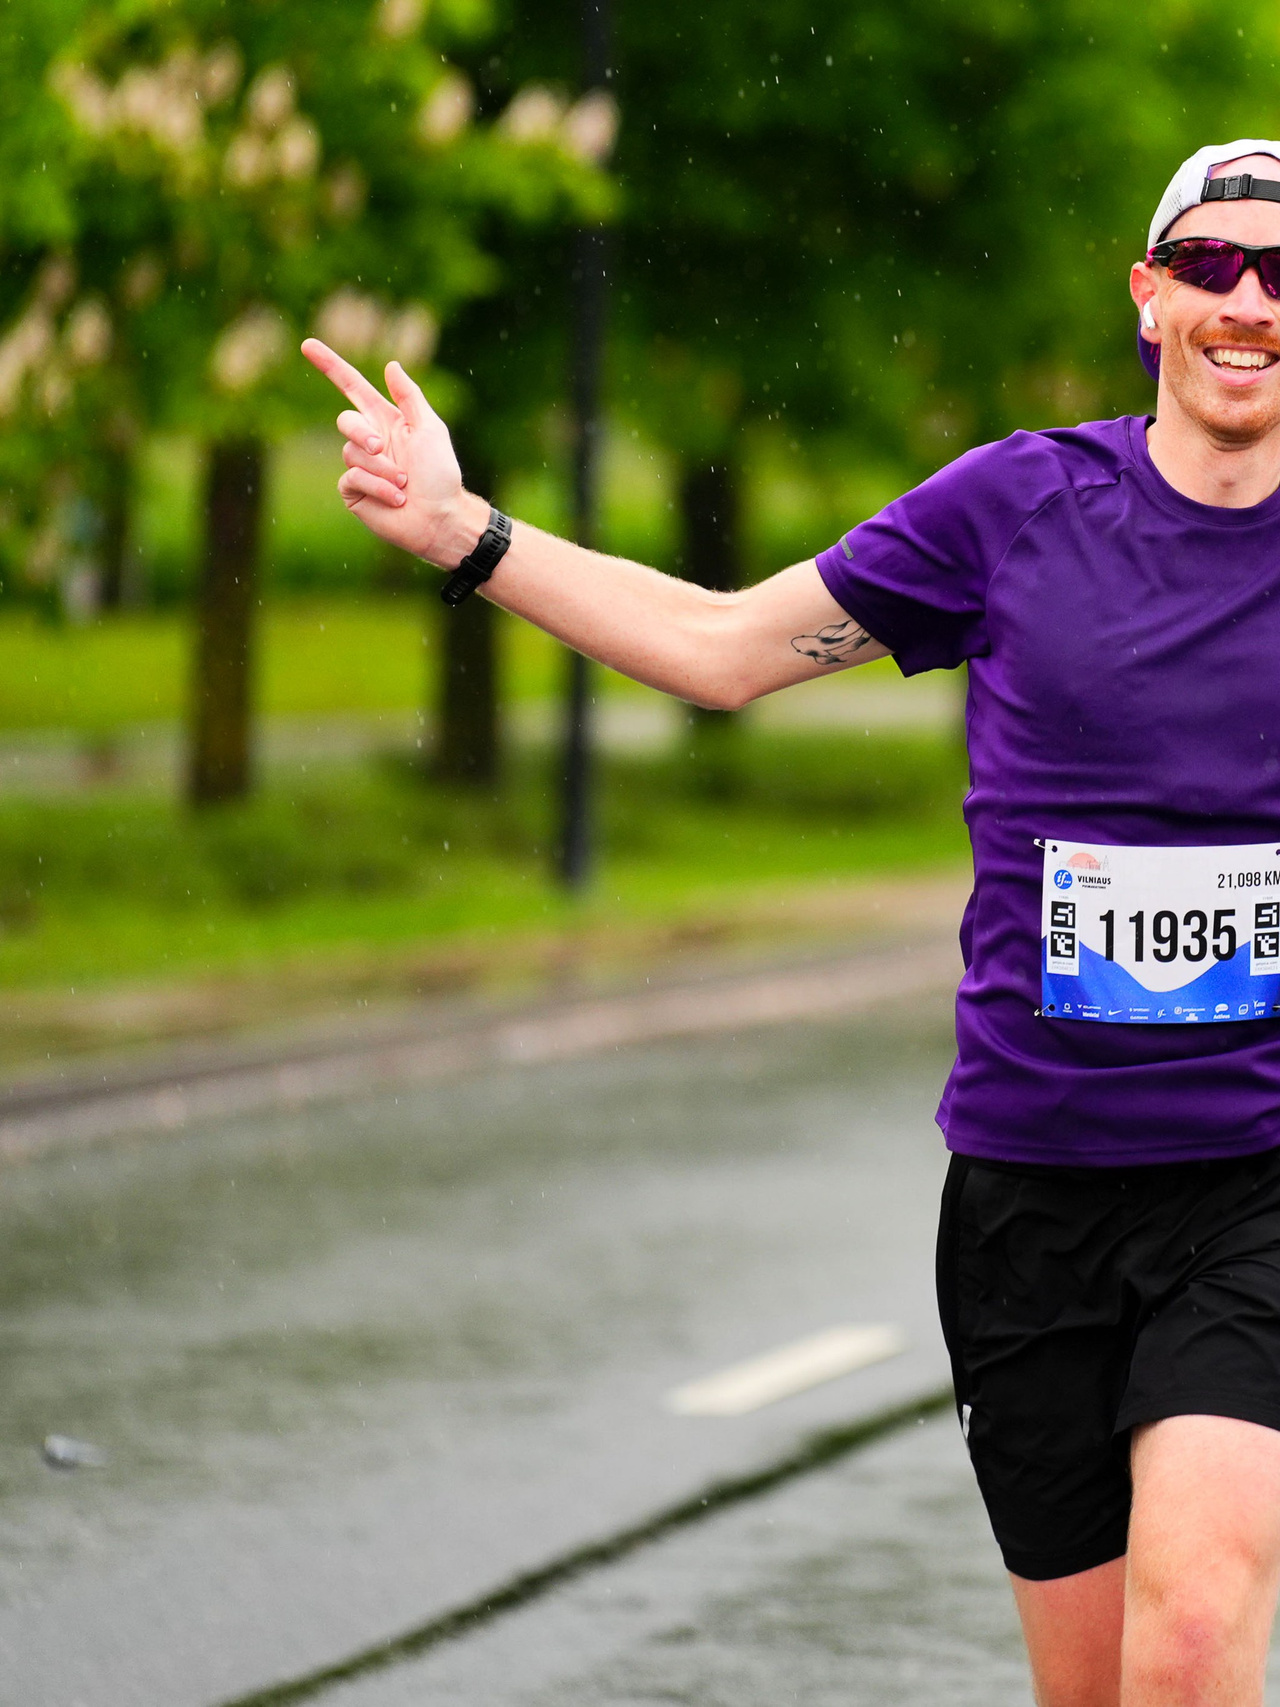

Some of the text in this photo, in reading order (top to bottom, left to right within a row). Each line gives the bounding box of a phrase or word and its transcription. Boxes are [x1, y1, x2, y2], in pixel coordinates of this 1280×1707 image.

[1077, 875, 1112, 885] VILNIAUS
[1218, 871, 1261, 889] 21,098
[1099, 908, 1237, 963] 11935
